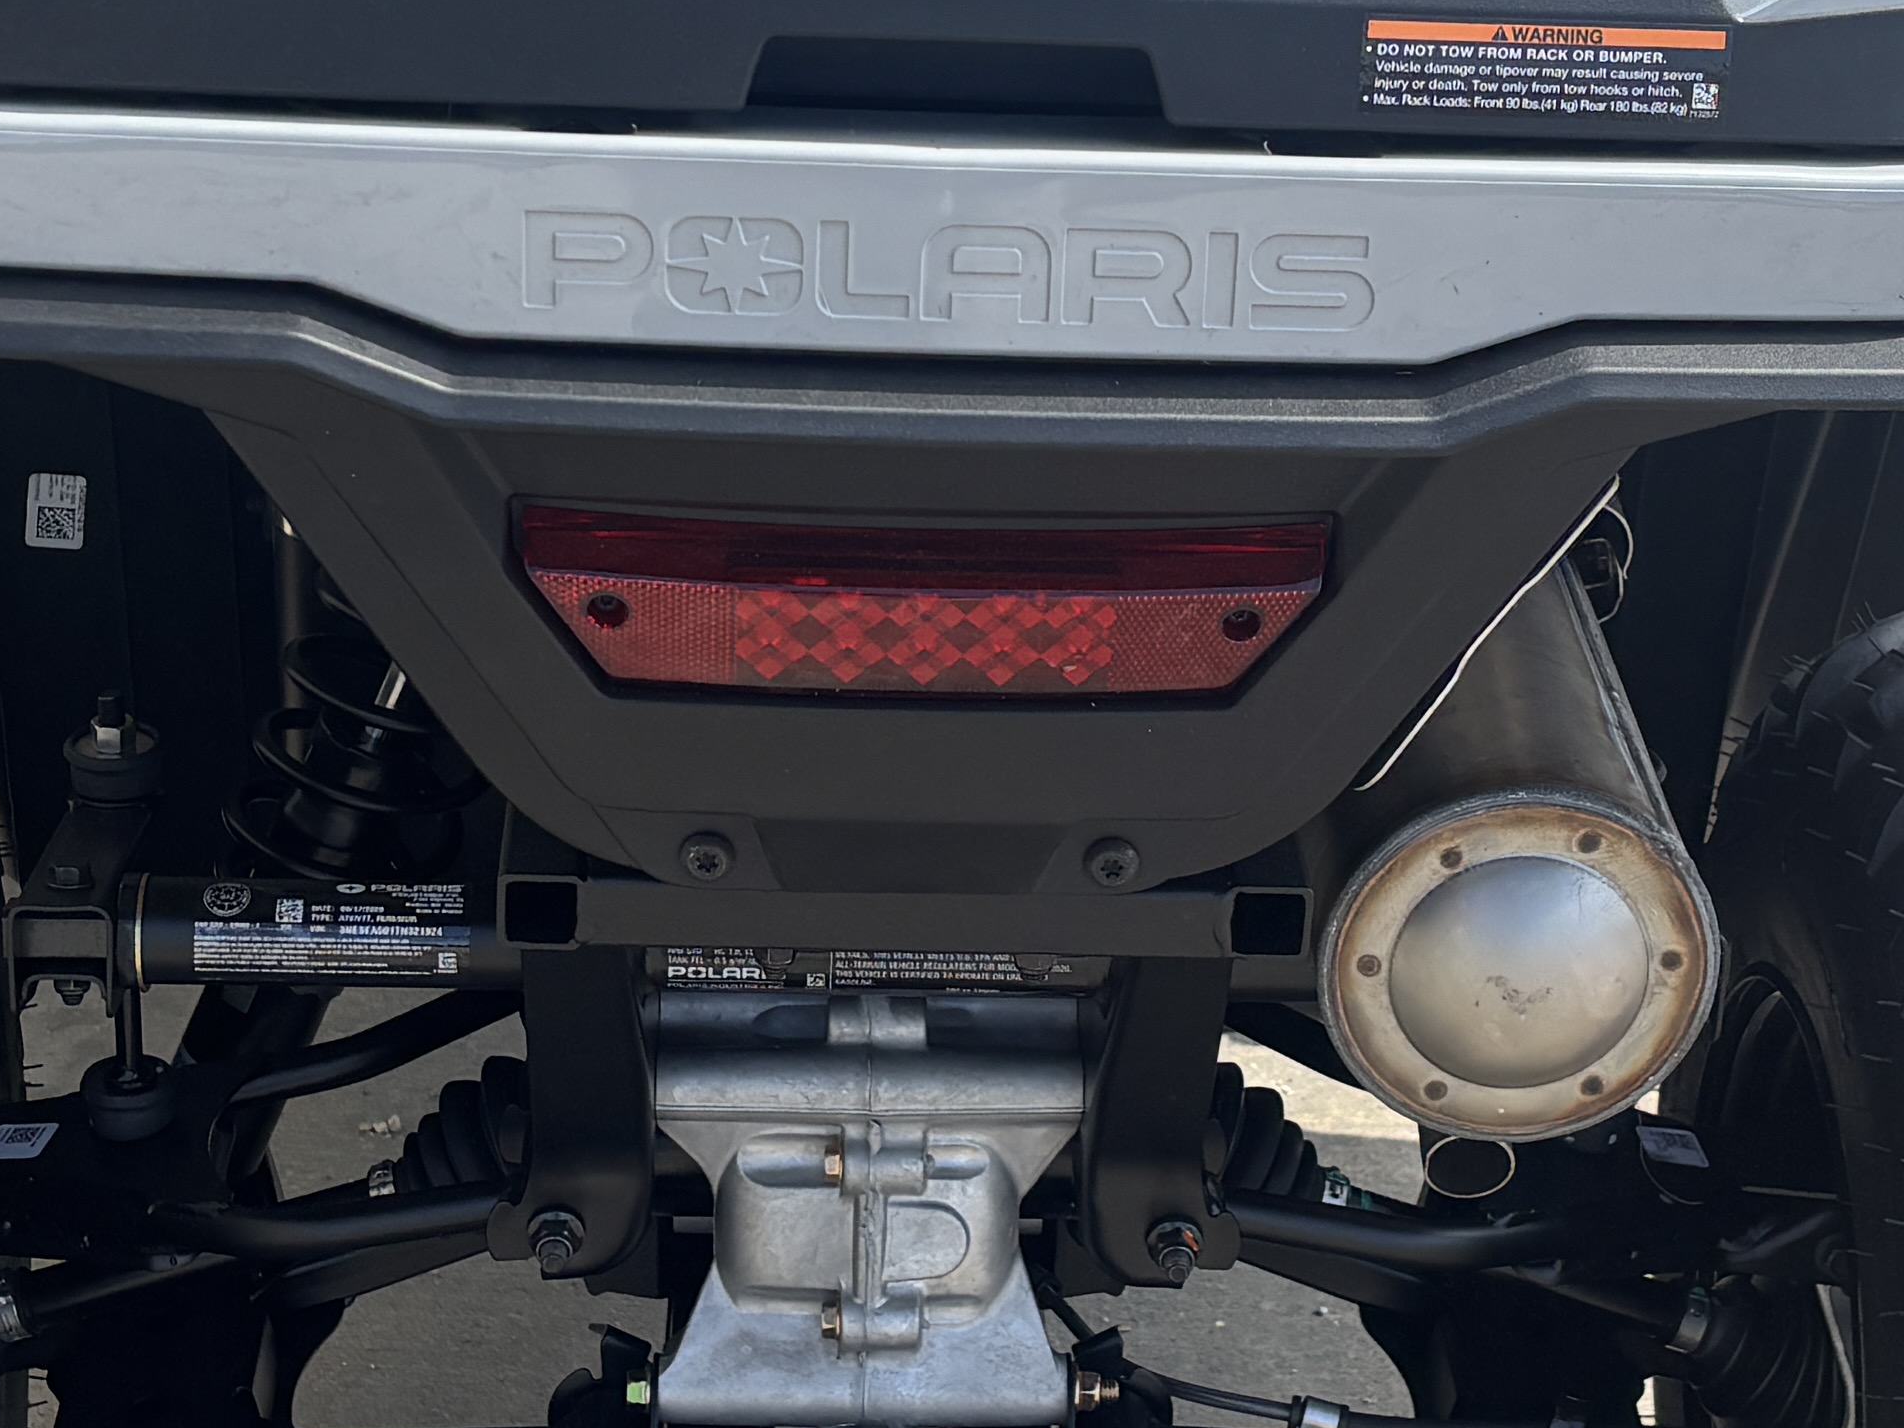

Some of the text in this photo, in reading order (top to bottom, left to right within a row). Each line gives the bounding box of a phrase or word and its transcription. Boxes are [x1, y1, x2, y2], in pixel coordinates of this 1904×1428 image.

[1512, 26, 1603, 44] WARNING
[1377, 43, 1668, 64] DO NOT TOW FROM RACK OR BUMPER.
[1375, 59, 1704, 83] Vehicle damage or tipover may result causing severe
[1374, 76, 1684, 98] injury or death. Tow only from tow hooks or hitch.
[1401, 93, 1431, 106] Rack
[1433, 94, 1472, 108] Loads:
[1474, 95, 1504, 109] Front
[1505, 97, 1521, 109] 90
[1560, 98, 1580, 114] kg)
[1580, 99, 1607, 112] Rear
[1609, 100, 1630, 113] 180
[1669, 101, 1688, 117] kg)
[521, 208, 1376, 334] POLARIS
[370, 883, 465, 893] POLARIS
[667, 966, 786, 980] POLARI
[835, 960, 887, 968] ALL-TERRAIN
[889, 961, 920, 969] VEHICLE
